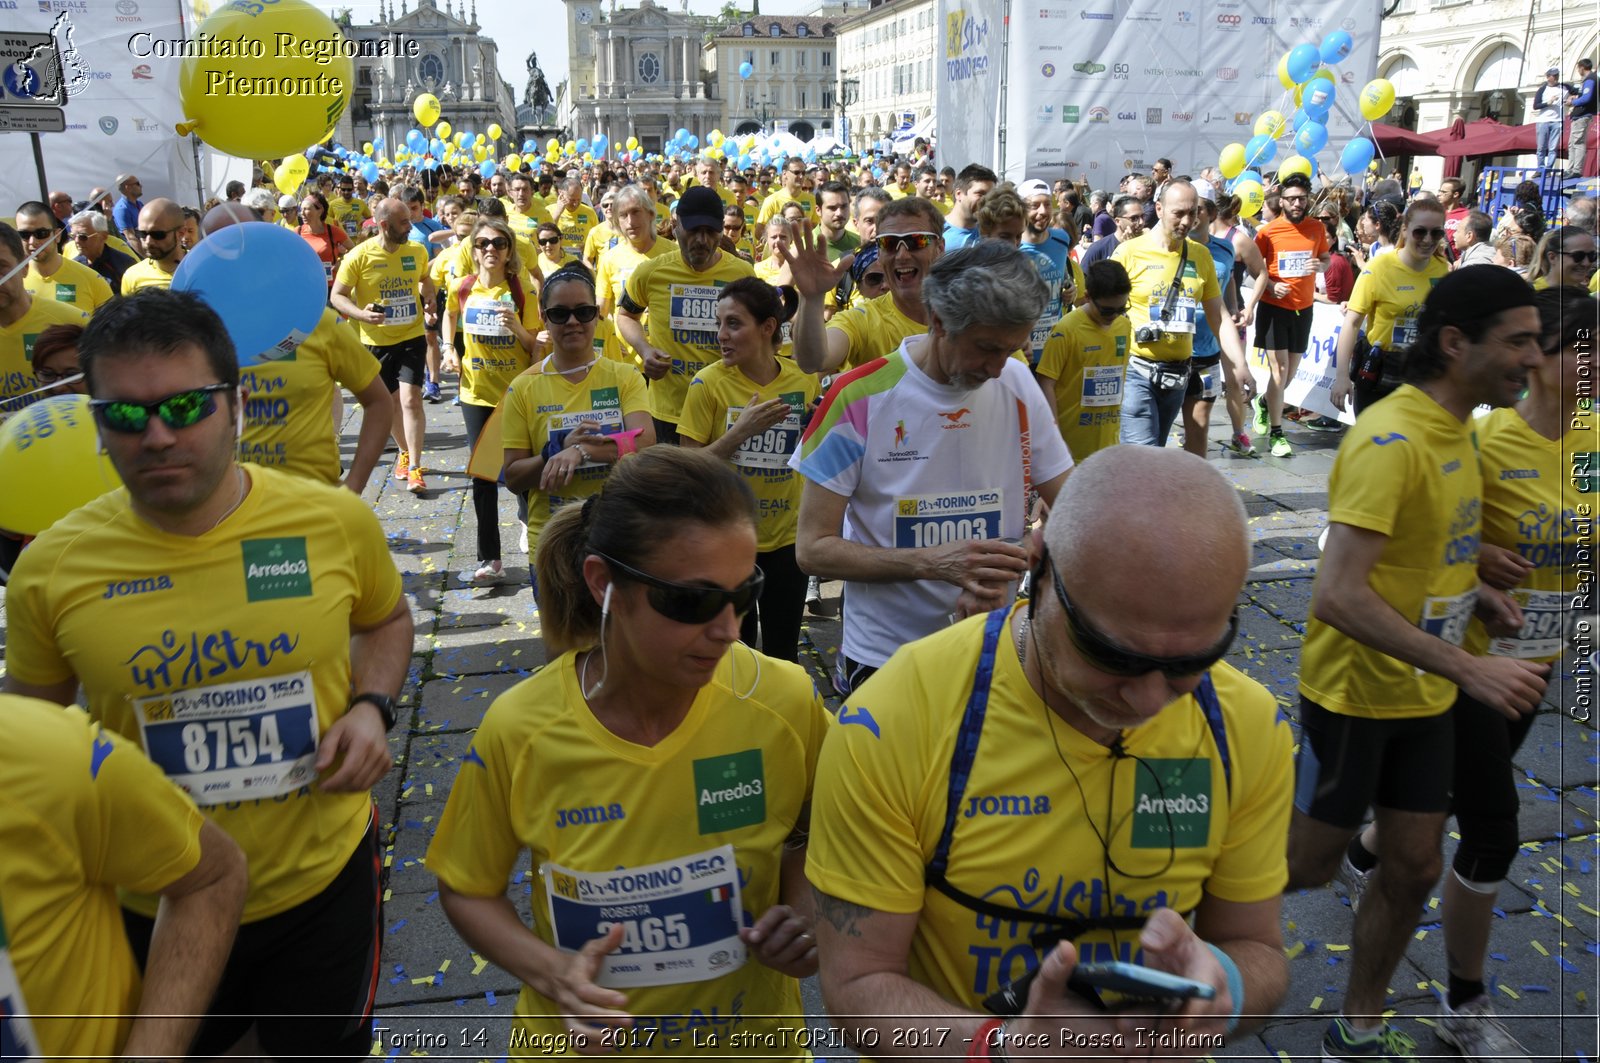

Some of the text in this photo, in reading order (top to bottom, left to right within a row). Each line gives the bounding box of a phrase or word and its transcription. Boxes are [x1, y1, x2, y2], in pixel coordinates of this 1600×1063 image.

[1217, 14, 1242, 26] coop
[947, 57, 971, 82] TORINO
[1113, 63, 1129, 74] GO
[1117, 112, 1137, 121] Cuki
[1172, 111, 1194, 122] inalpi
[380, 288, 413, 299] TORINO
[472, 334, 516, 346] TORINO
[486, 359, 516, 367] REALE
[1095, 382, 1118, 395] 5567
[593, 398, 618, 408] Arredo3
[979, 493, 999, 502] 150
[910, 517, 987, 548] 10003
[247, 559, 308, 579] Arredo3
[269, 679, 305, 694] 150
[181, 713, 285, 773] 8754
[700, 779, 763, 806] Arredo3
[1136, 793, 1209, 815] Arredo3
[685, 855, 726, 873] 150
[600, 904, 652, 918] ROBERTA
